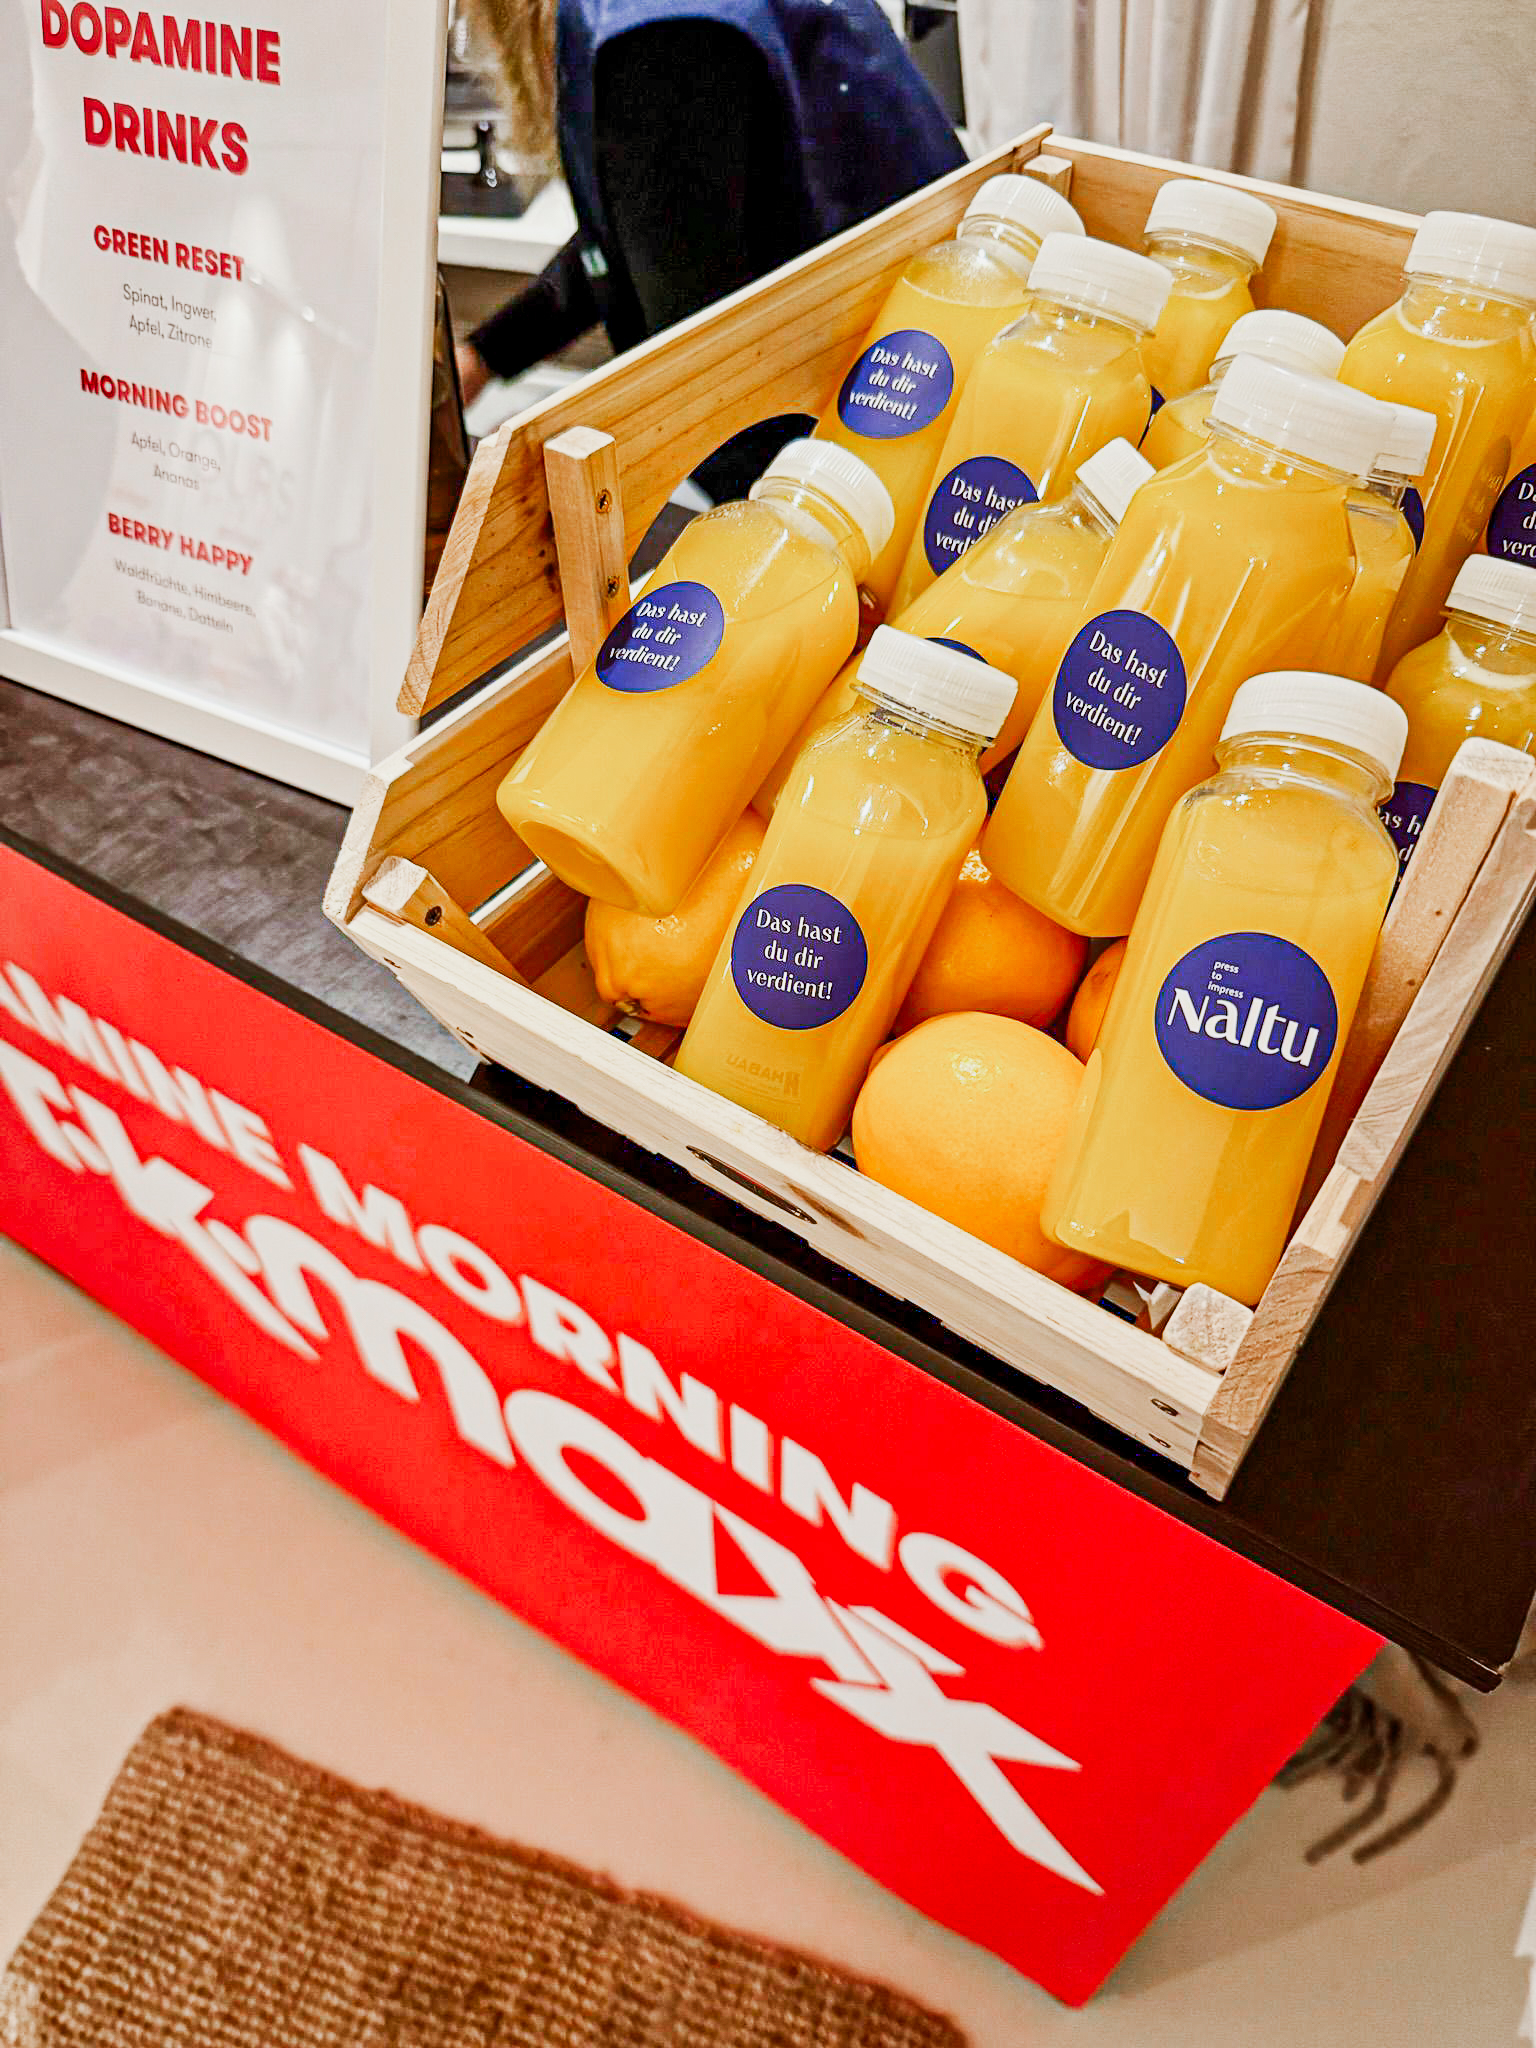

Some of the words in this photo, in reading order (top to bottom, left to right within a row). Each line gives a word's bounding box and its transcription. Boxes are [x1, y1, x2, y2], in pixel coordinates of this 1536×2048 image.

[40, 0, 281, 85] DOPAMINE
[83, 96, 249, 175] DRINKS
[94, 225, 169, 265] GREEN
[175, 242, 245, 281] RESET
[123, 283, 168, 311] Spinat,
[171, 296, 217, 324] Ingwer,
[129, 314, 165, 340] Apfel,
[167, 323, 213, 349] Zitrone
[870, 346, 900, 367] Das
[902, 351, 940, 380] hast
[868, 368, 889, 388] du
[891, 374, 917, 396] dir
[80, 368, 189, 419] MORNING
[194, 399, 273, 442] BOOST
[849, 390, 918, 421] verdient!
[131, 430, 166, 457] Apfel,
[168, 442, 221, 473] Orange,
[153, 464, 200, 491] Ananas
[951, 476, 982, 503] Das
[953, 506, 975, 530] du
[107, 511, 173, 551] BERRY
[180, 534, 255, 577] HAPPY
[188, 606, 234, 634] Datteln
[635, 601, 666, 619] Das
[667, 603, 708, 628] hast
[631, 622, 653, 640] du
[655, 625, 681, 645] dir
[609, 645, 681, 672] verdient!
[1089, 630, 1123, 664] Das
[1124, 648, 1169, 689] hast
[1087, 667, 1112, 695] du
[1113, 682, 1142, 710] dir
[1065, 691, 1143, 746] verdient!
[1378, 806, 1402, 829] as
[756, 908, 791, 934] Das
[797, 916, 842, 945] hast
[764, 939, 788, 963] du
[794, 946, 824, 969] dir
[1213, 960, 1240, 974] press
[746, 968, 833, 1000] verdient!
[1207, 981, 1244, 999] impress
[1211, 970, 1222, 981] to
[1166, 987, 1320, 1068] Naltu
[299, 1142, 1044, 1653] MORNING
